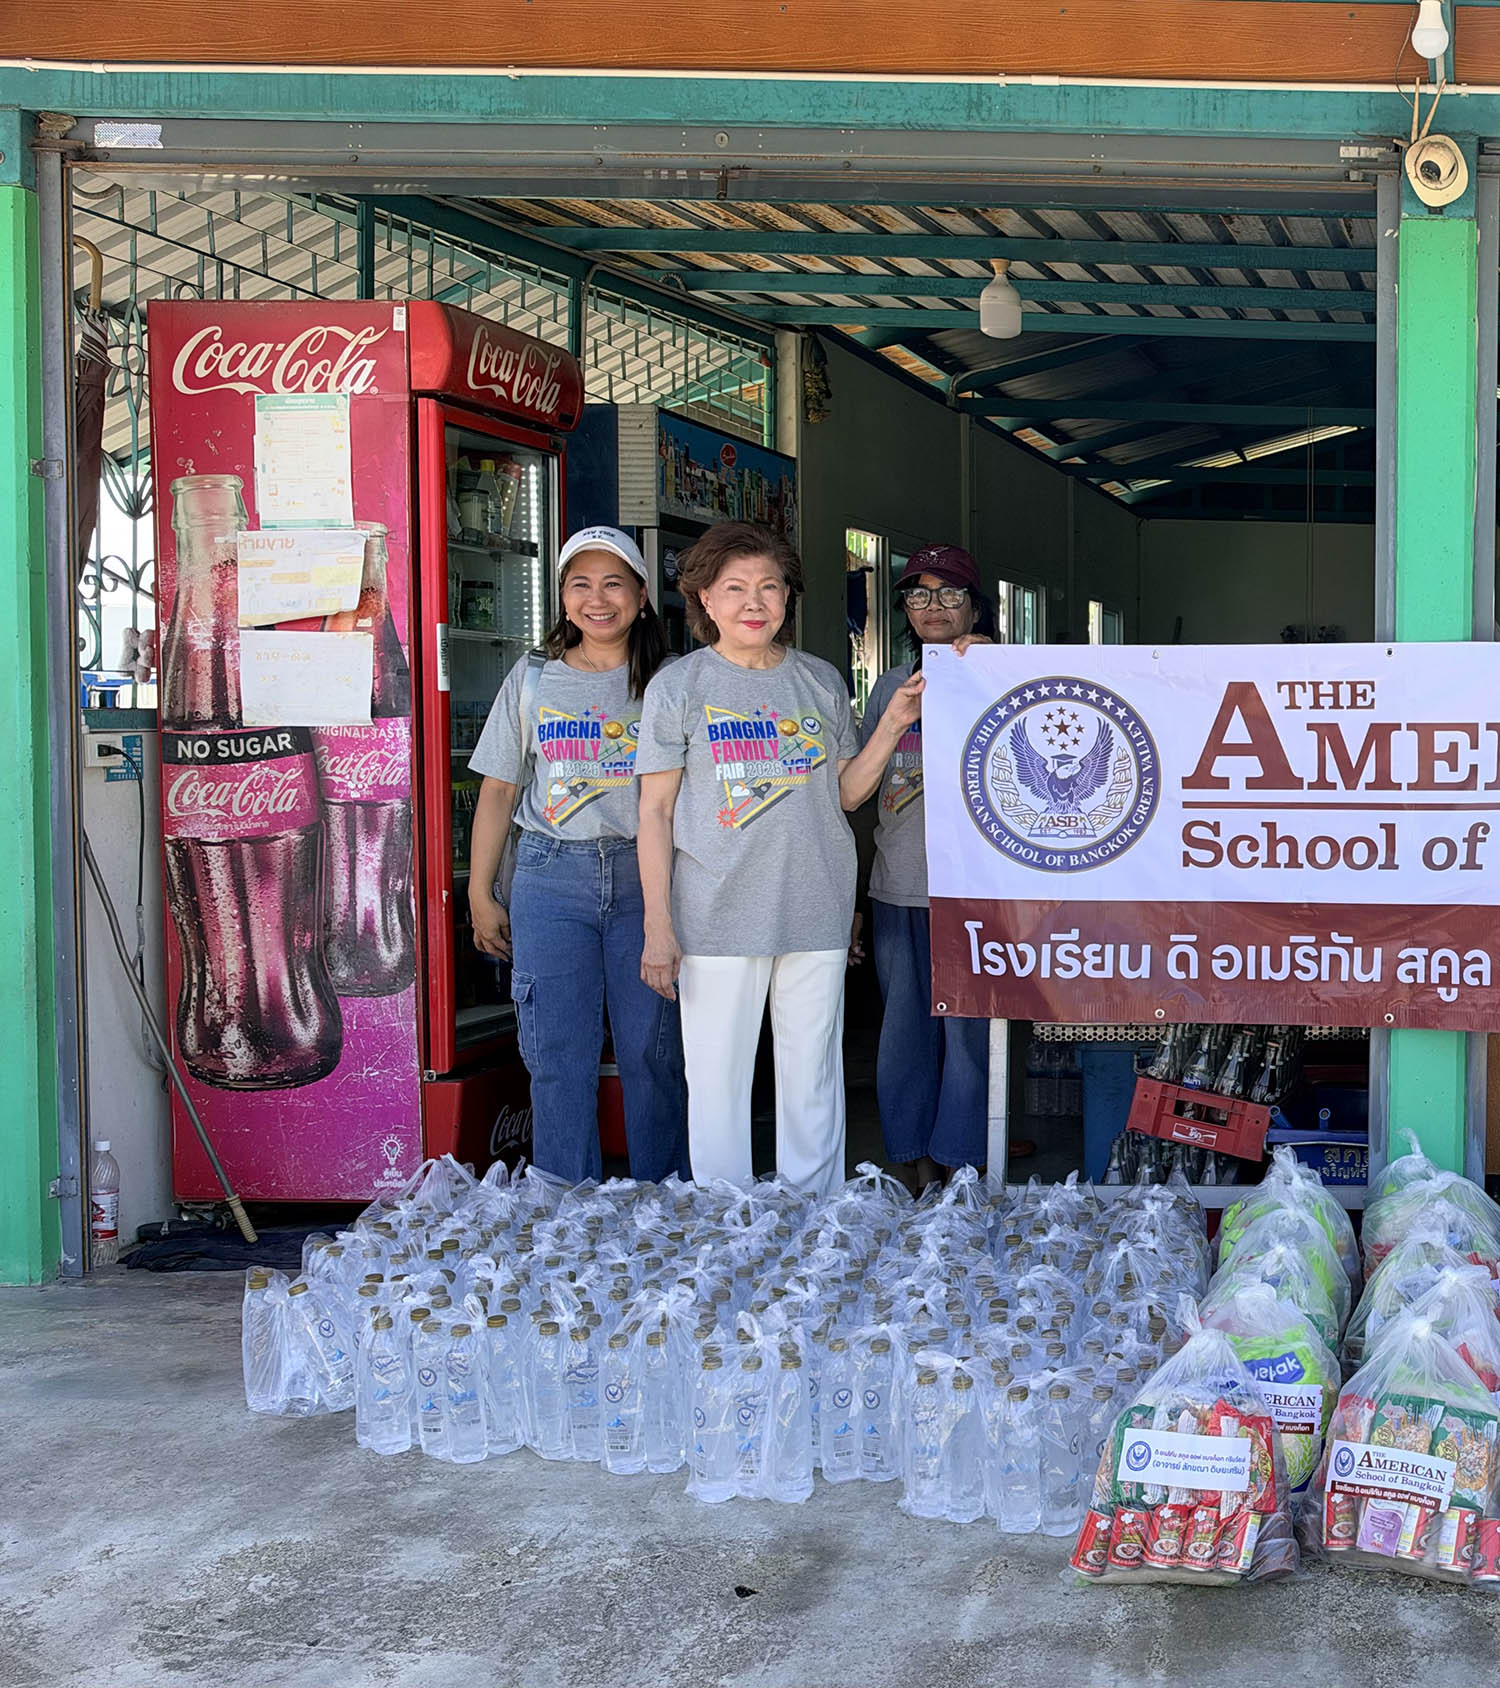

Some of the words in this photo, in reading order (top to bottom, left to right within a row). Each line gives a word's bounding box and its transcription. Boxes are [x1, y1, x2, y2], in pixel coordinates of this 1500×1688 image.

[173, 326, 389, 394] Coca-Cola
[467, 325, 561, 414] Coca-Cola
[1277, 680, 1376, 712] THE
[538, 721, 600, 743] BANGNA
[707, 721, 778, 742] BANGNA
[978, 719, 1000, 747] THE
[177, 740, 211, 759] NO
[217, 734, 293, 757] SUGAR
[541, 739, 600, 763] FAMILY
[711, 739, 779, 764] FAMILY
[1124, 720, 1153, 775] VALLEY
[565, 762, 600, 777] 2026
[715, 762, 746, 781] FAIR
[747, 761, 782, 778] 2026
[168, 767, 304, 817] Coca-Cola
[967, 745, 993, 824] AMERICAN
[1132, 776, 1153, 827] GREEN
[1046, 816, 1079, 827] ASB
[986, 822, 1042, 864] SCHOOL
[1069, 825, 1137, 867] BANGKOK
[1182, 822, 1396, 871] School
[1421, 821, 1491, 871] of
[1045, 855, 1065, 867] OF
[964, 920, 1152, 981] โรงเรียน
[1168, 926, 1201, 981] ดิ
[1211, 931, 1383, 984] อเมริกัน
[1396, 940, 1493, 1001] สคูล
[1264, 1394, 1316, 1406] ERICAN
[1275, 1409, 1315, 1419] Bangkok
[1357, 1451, 1447, 1481] AMERICAN
[1355, 1471, 1386, 1482] School
[1389, 1475, 1399, 1483] of
[1402, 1478, 1444, 1493] Bangkok
